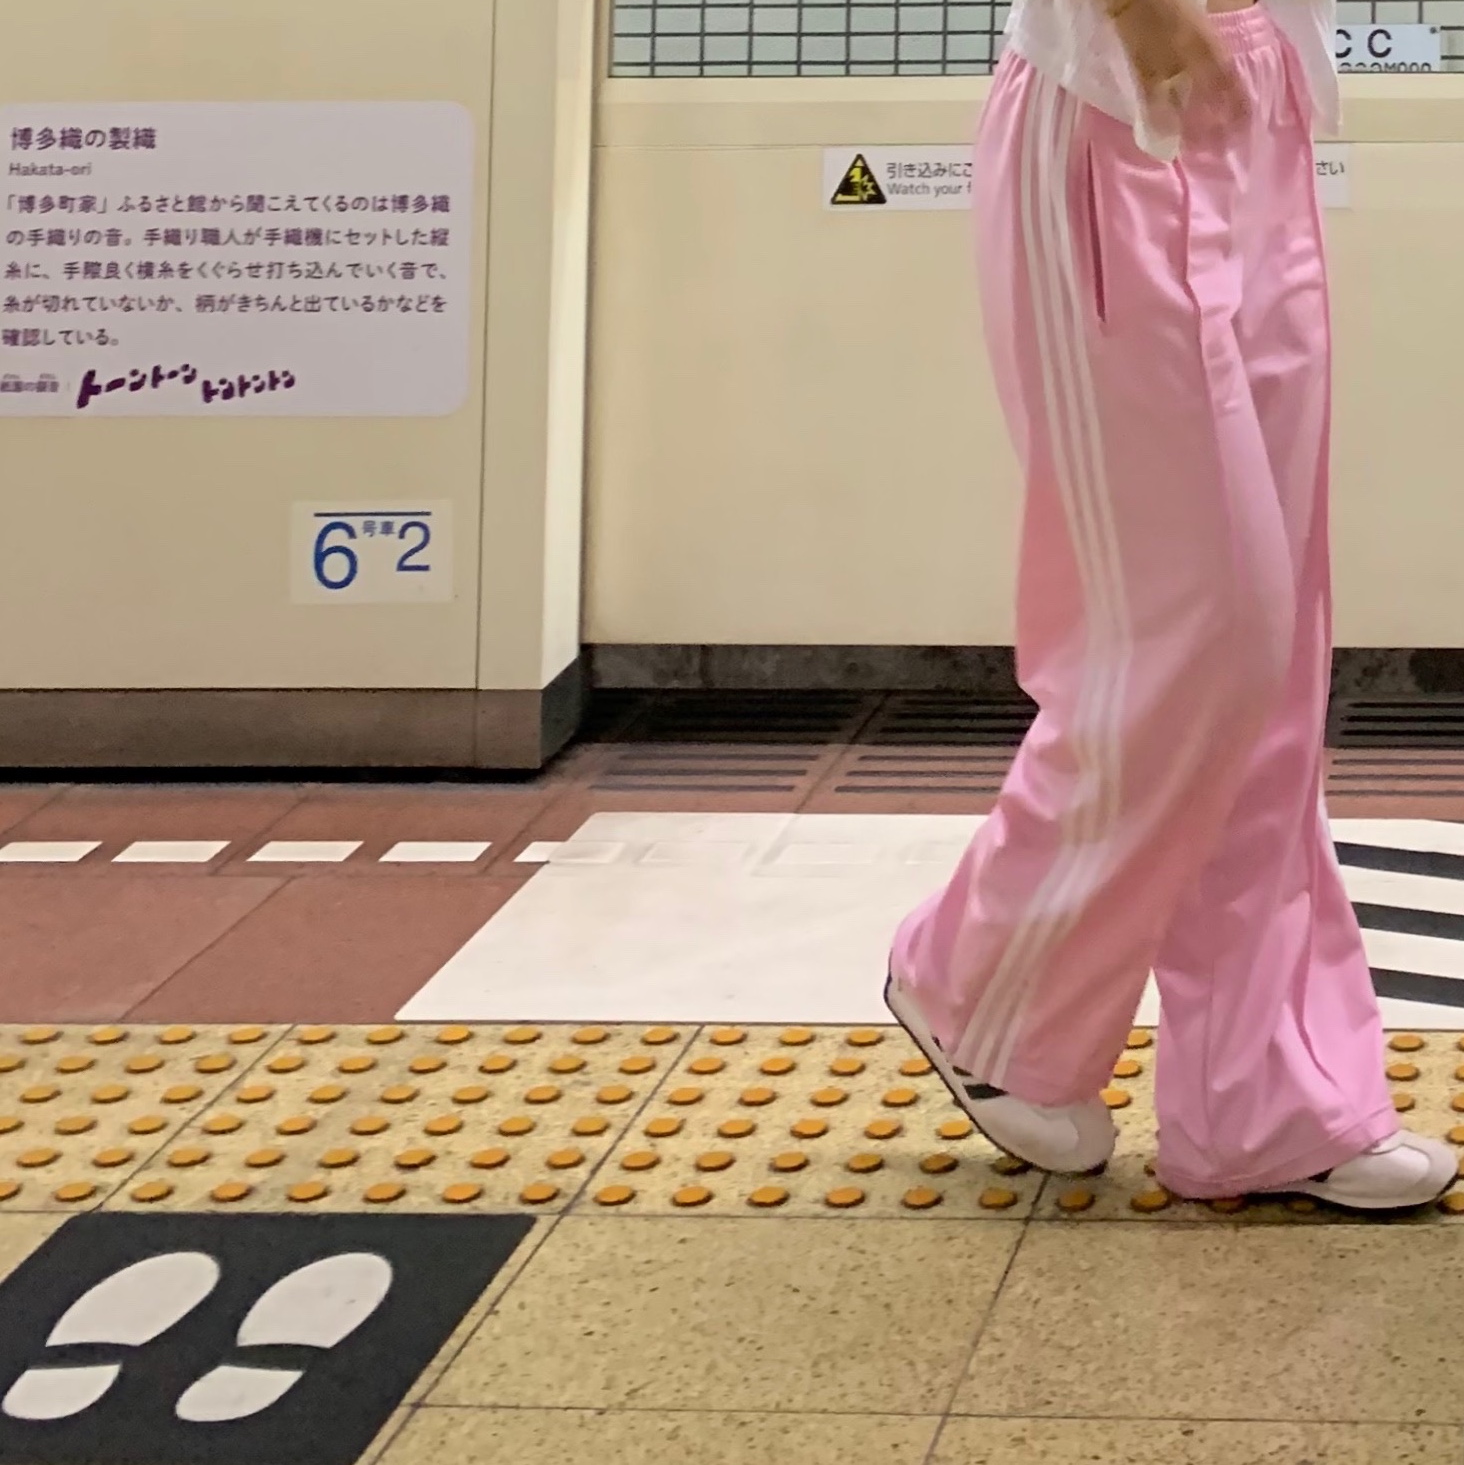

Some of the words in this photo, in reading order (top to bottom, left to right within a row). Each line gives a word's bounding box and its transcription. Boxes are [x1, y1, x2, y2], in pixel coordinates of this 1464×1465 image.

[8, 162, 92, 177] Hakata-ori
[887, 182, 930, 196] Watch
[933, 185, 963, 198] your
[313, 521, 358, 590] 6
[396, 520, 431, 572] 2
